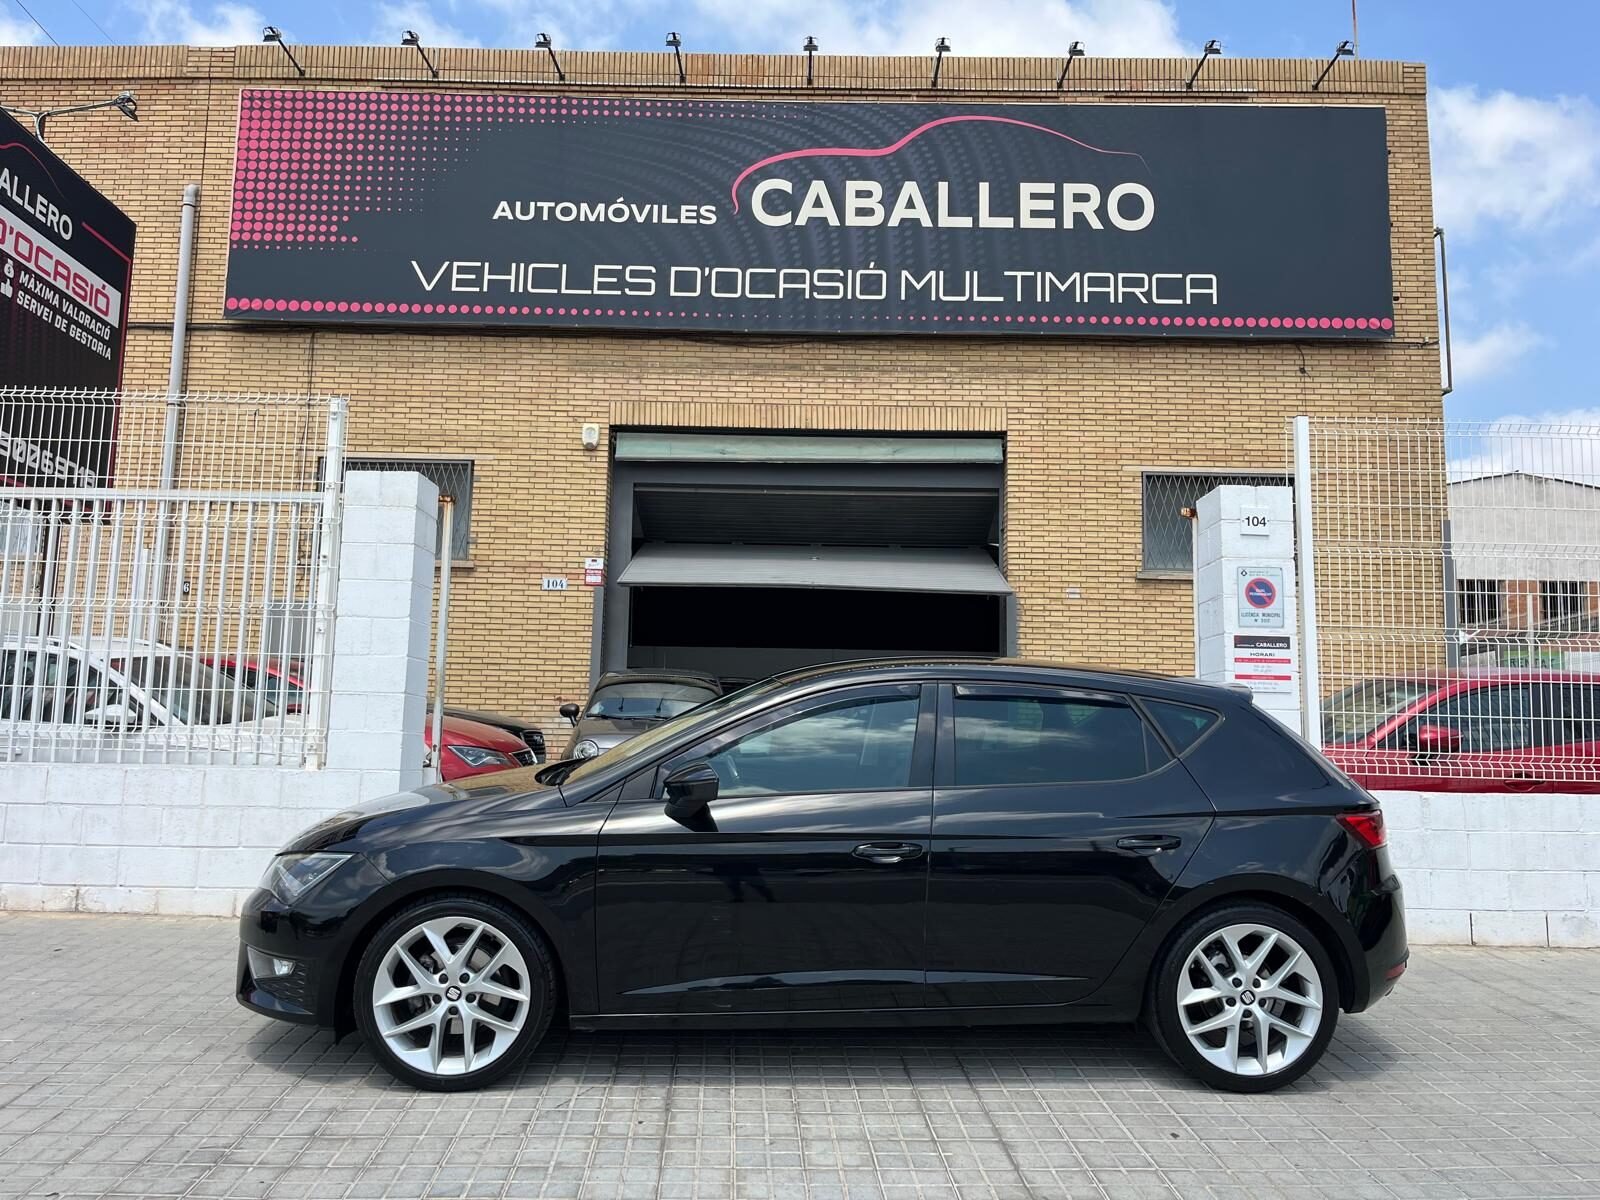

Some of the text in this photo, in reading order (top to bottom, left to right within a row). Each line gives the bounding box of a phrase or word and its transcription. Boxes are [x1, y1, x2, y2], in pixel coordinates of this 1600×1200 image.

[492, 178, 1155, 232] AUTOMÓVILES CABALLERO
[18, 270, 111, 341] MÀXIMA VALORACIÓ
[411, 260, 1218, 305] VEHICLES D'OCASIÓ MULTIMARCA
[16, 290, 112, 361] SERVEI DE GESTORIA
[1245, 515, 1267, 527] 104
[547, 579, 564, 589] 104
